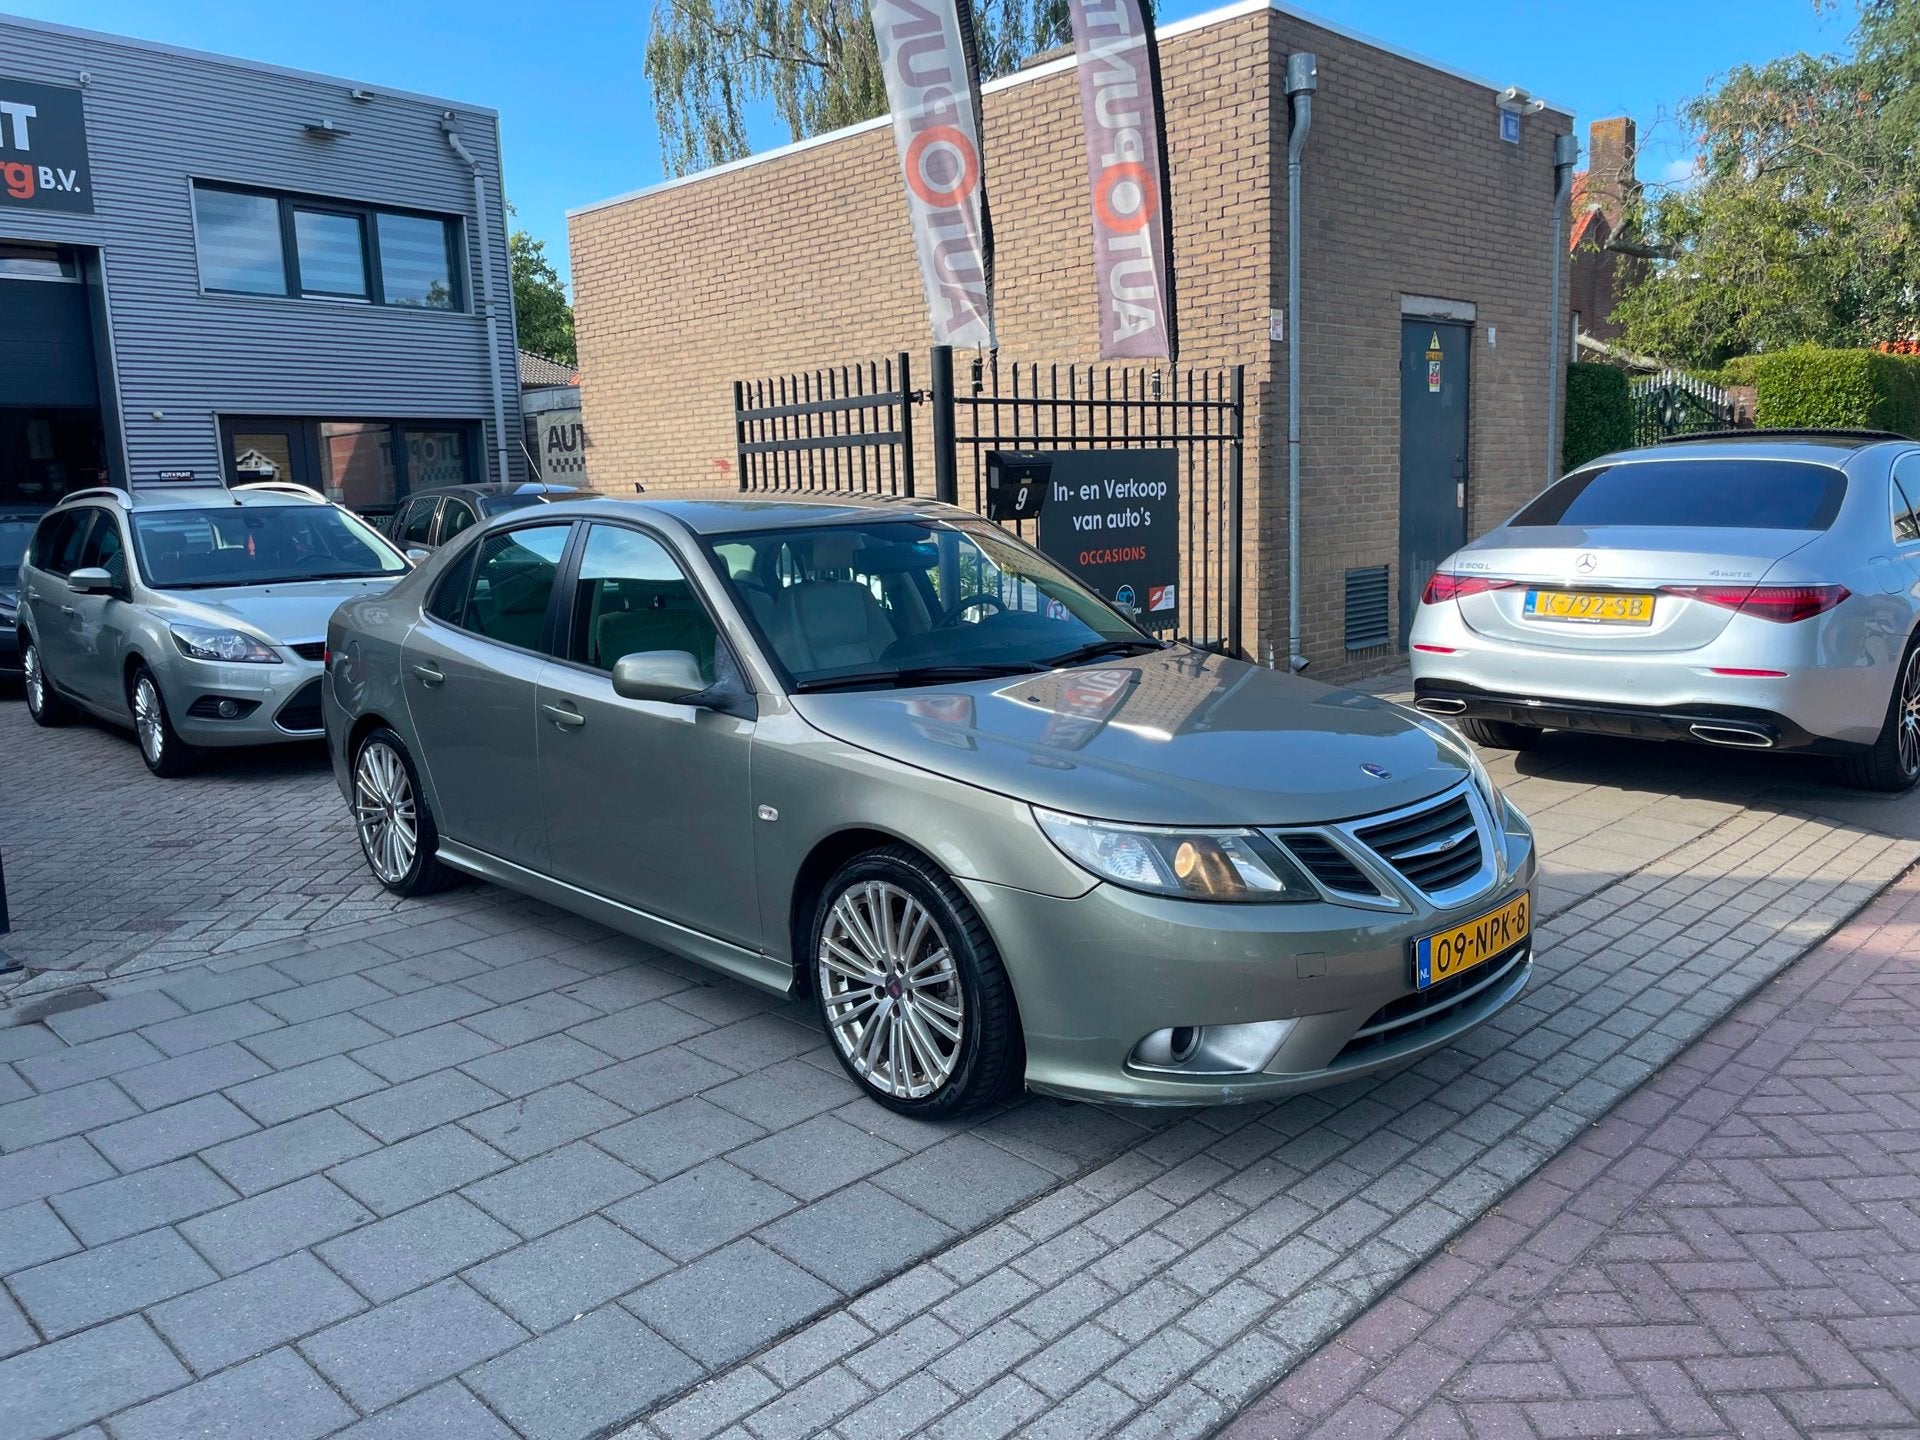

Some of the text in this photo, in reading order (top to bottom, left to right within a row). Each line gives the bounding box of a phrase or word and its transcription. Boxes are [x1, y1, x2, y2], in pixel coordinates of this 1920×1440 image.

[0, 101, 37, 151] T
[38, 166, 81, 192] B.V.
[1015, 487, 1028, 511] 9
[1053, 478, 1167, 502] In- en Verkoop
[1072, 507, 1151, 531] van auto's
[1079, 545, 1147, 566] OCCASIONS
[1543, 593, 1643, 617] K-792-SB
[1437, 902, 1526, 973] 09-NPK-8
[1420, 969, 1430, 980] NL
